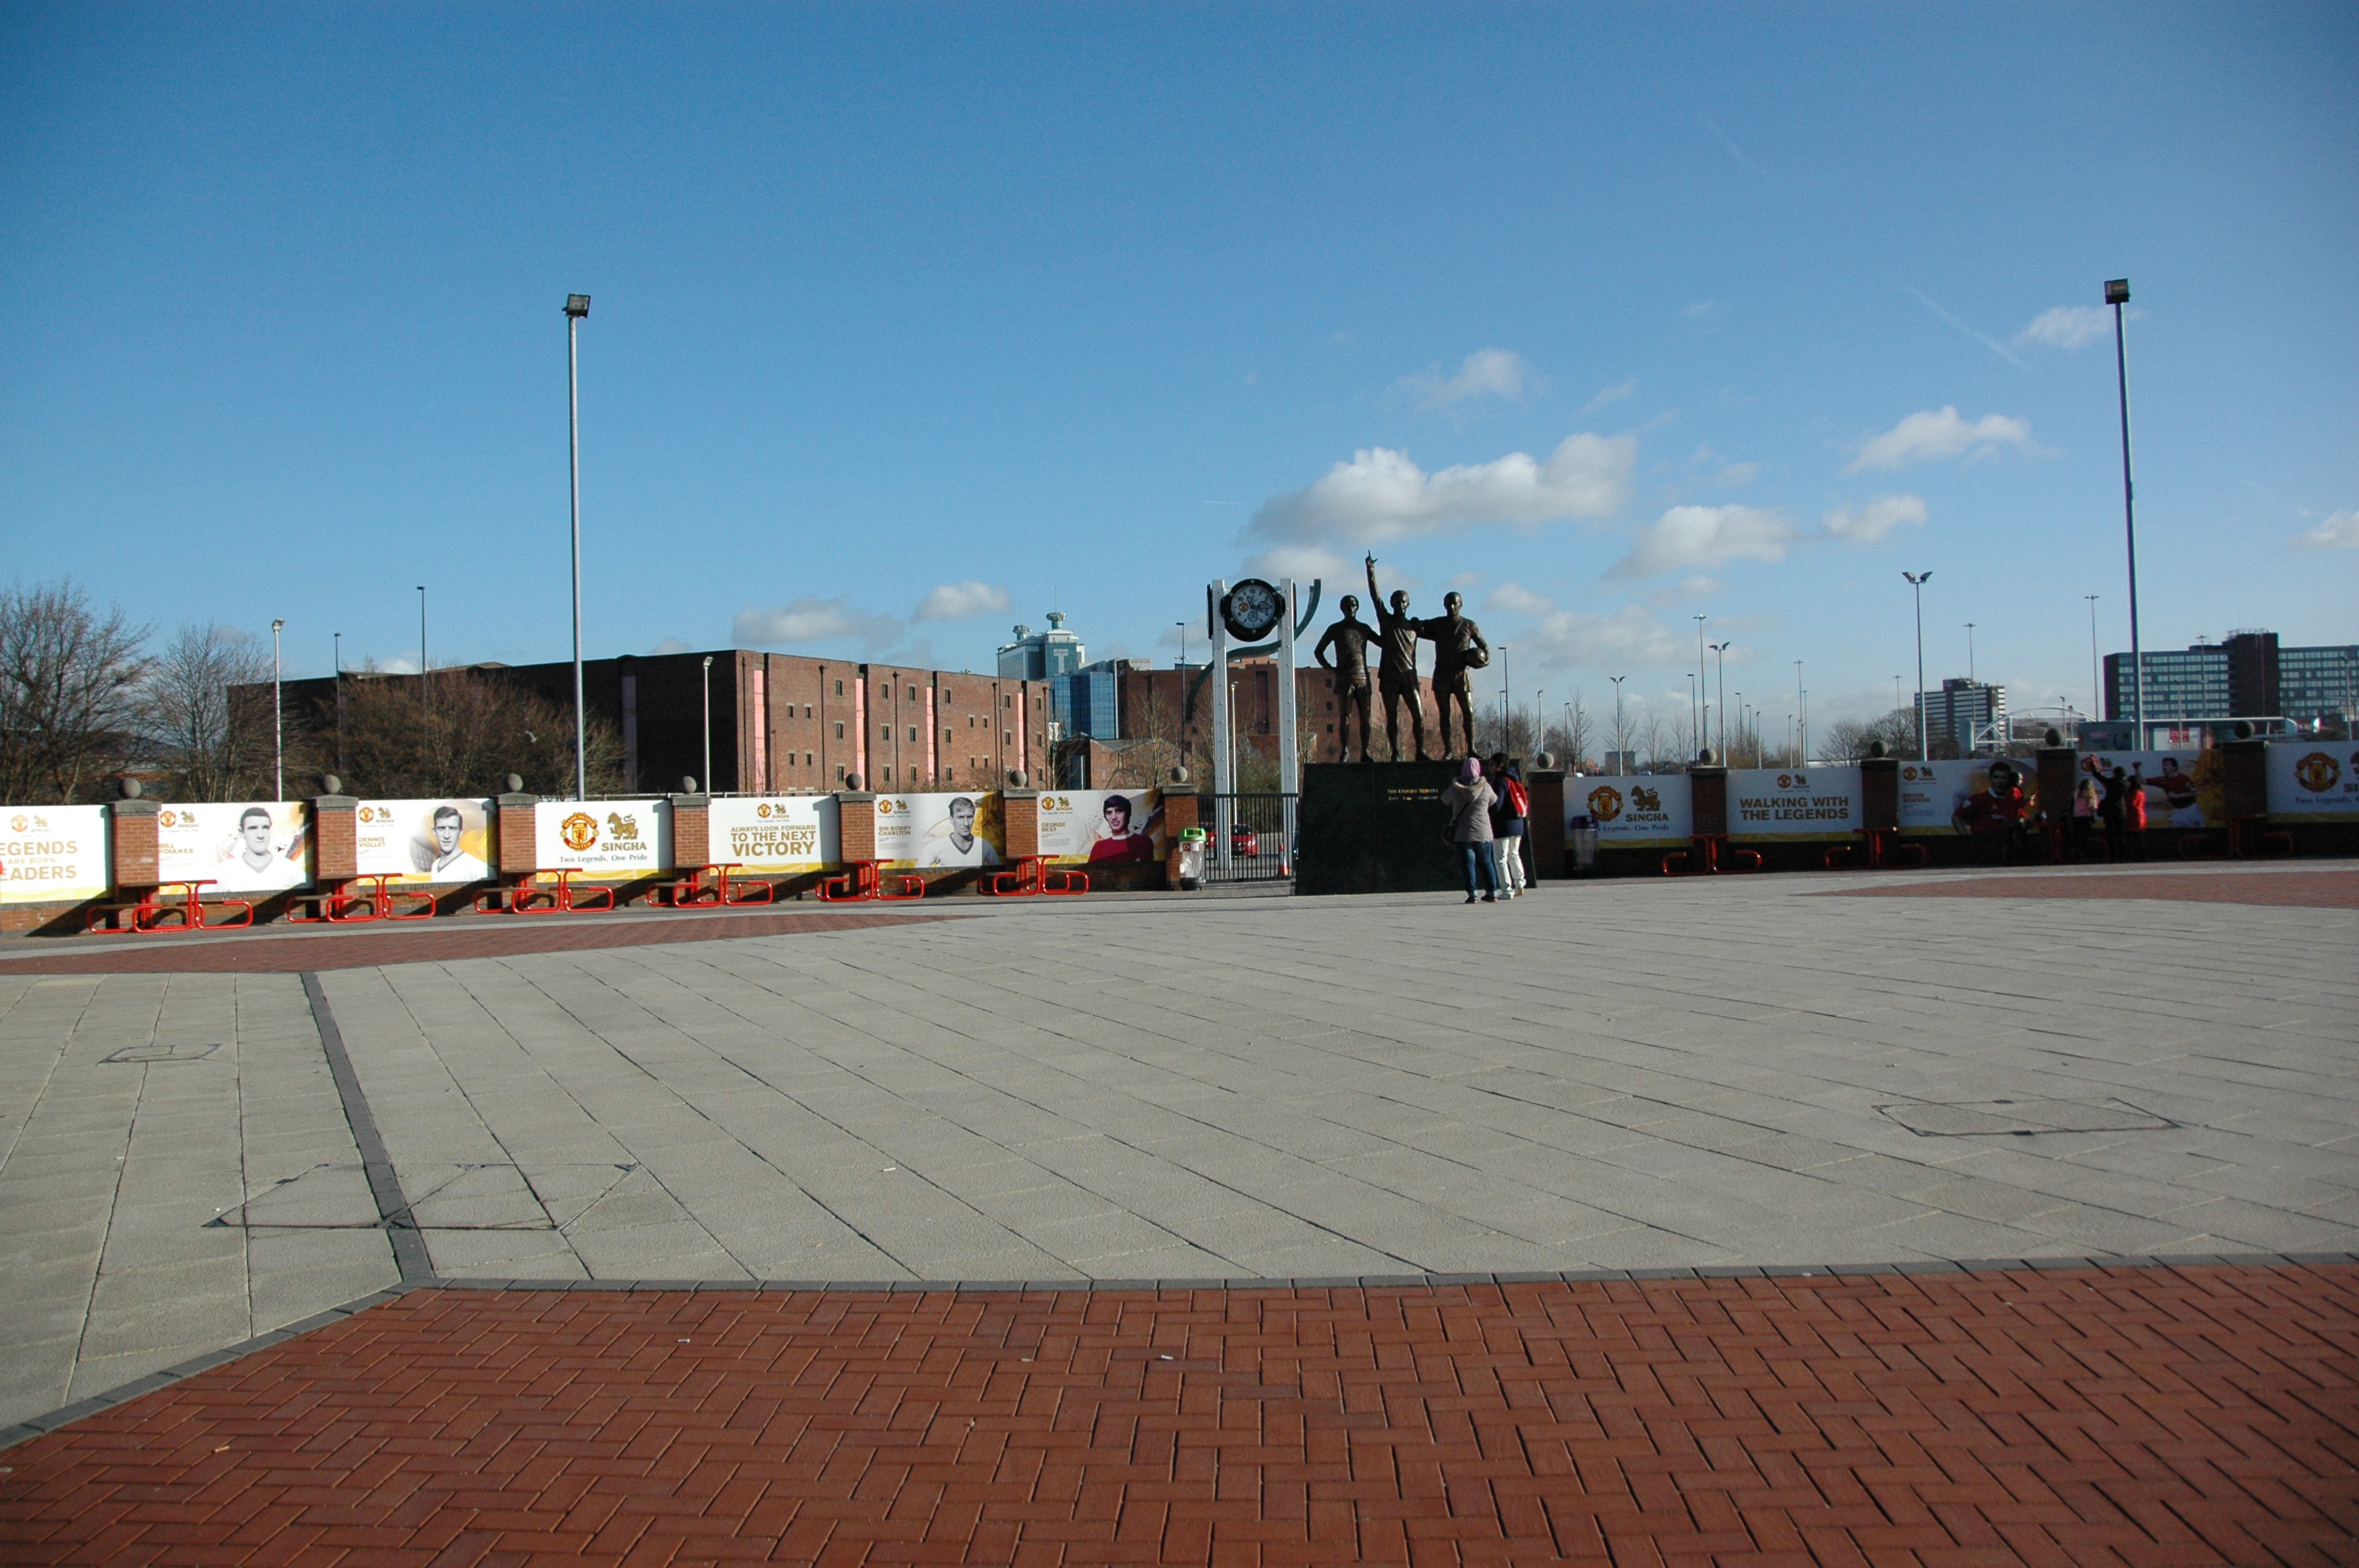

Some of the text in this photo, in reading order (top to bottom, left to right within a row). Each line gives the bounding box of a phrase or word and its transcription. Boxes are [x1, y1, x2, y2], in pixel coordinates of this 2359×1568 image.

[1739, 796, 1849, 808] WALKING WITH
[1625, 813, 1669, 822] SINGHA
[1741, 808, 1849, 821] THE LEGENDS
[731, 831, 816, 842] TO THE NEXT
[602, 842, 647, 851] SINGHA
[732, 841, 815, 857] VICTORY
